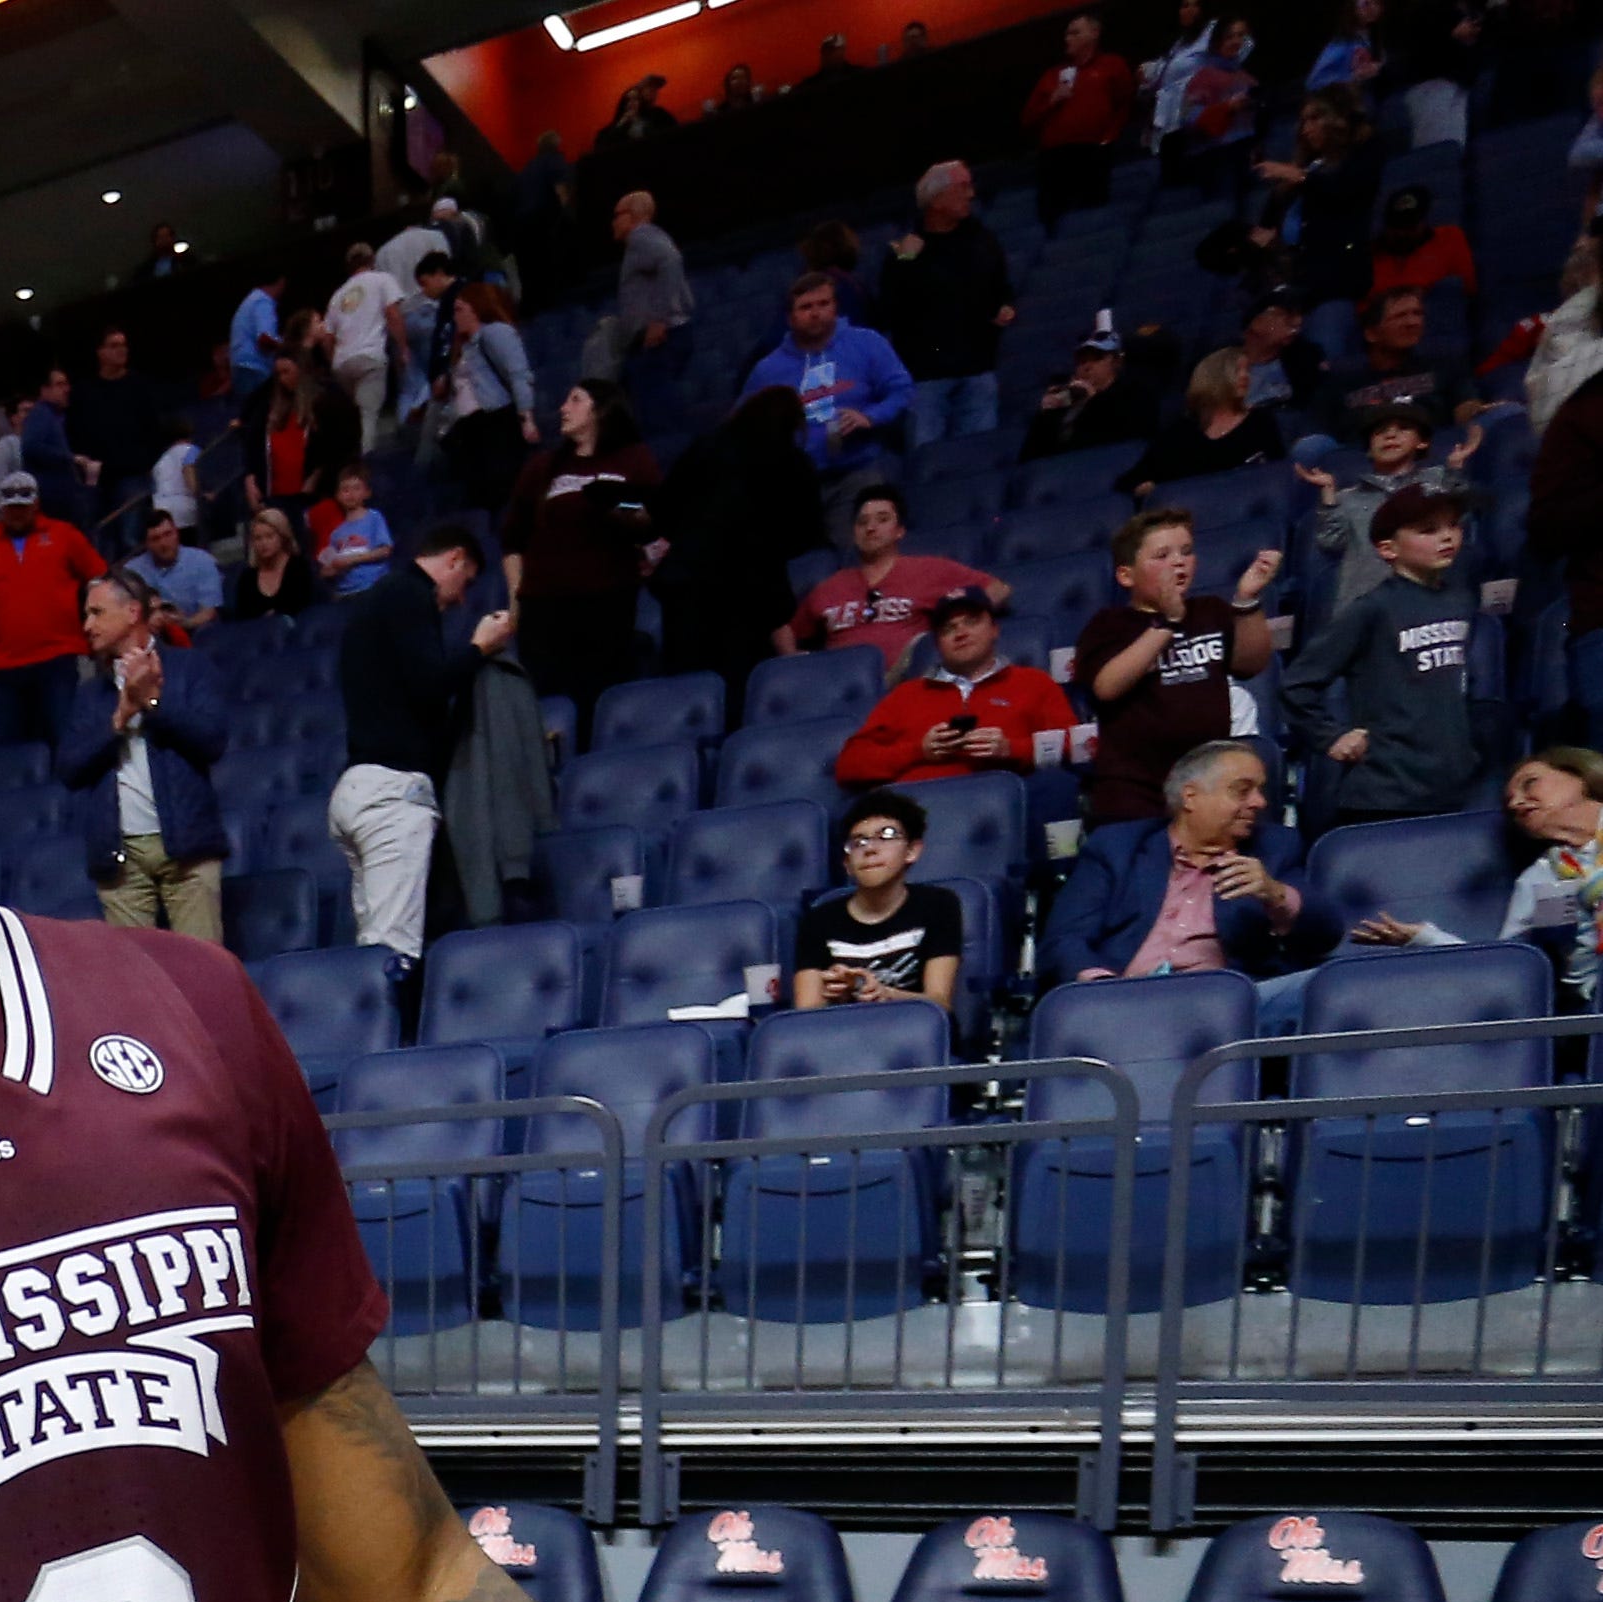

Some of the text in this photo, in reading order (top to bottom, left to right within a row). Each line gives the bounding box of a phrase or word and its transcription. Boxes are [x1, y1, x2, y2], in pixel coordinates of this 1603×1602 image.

[1156, 640, 1223, 670] LLDOG
[97, 1040, 157, 1090] SEC
[708, 1511, 753, 1542] Ole
[965, 1516, 1015, 1548] Ole
[1269, 1517, 1324, 1549] Ole
[716, 1540, 783, 1574] Miss
[973, 1546, 1046, 1580] Miss
[1281, 1548, 1363, 1584] Miss
